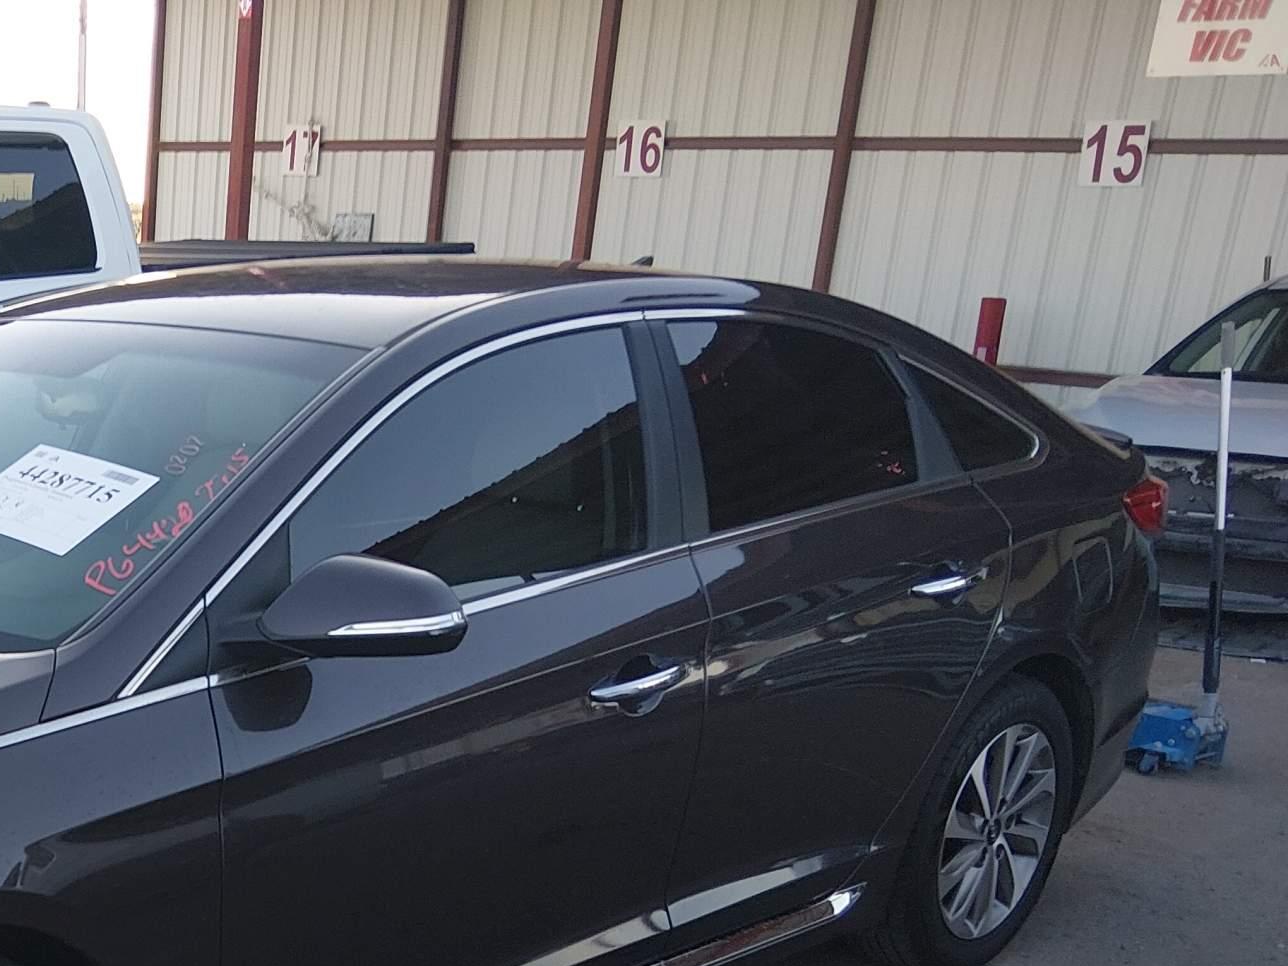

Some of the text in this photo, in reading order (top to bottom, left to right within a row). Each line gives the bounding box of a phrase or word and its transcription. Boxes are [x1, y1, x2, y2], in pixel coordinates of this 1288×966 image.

[1188, 28, 1253, 62] VIC
[285, 129, 319, 171] 17
[618, 125, 662, 173] 16
[1086, 124, 1147, 184] 15
[19, 464, 121, 503] 44287715
